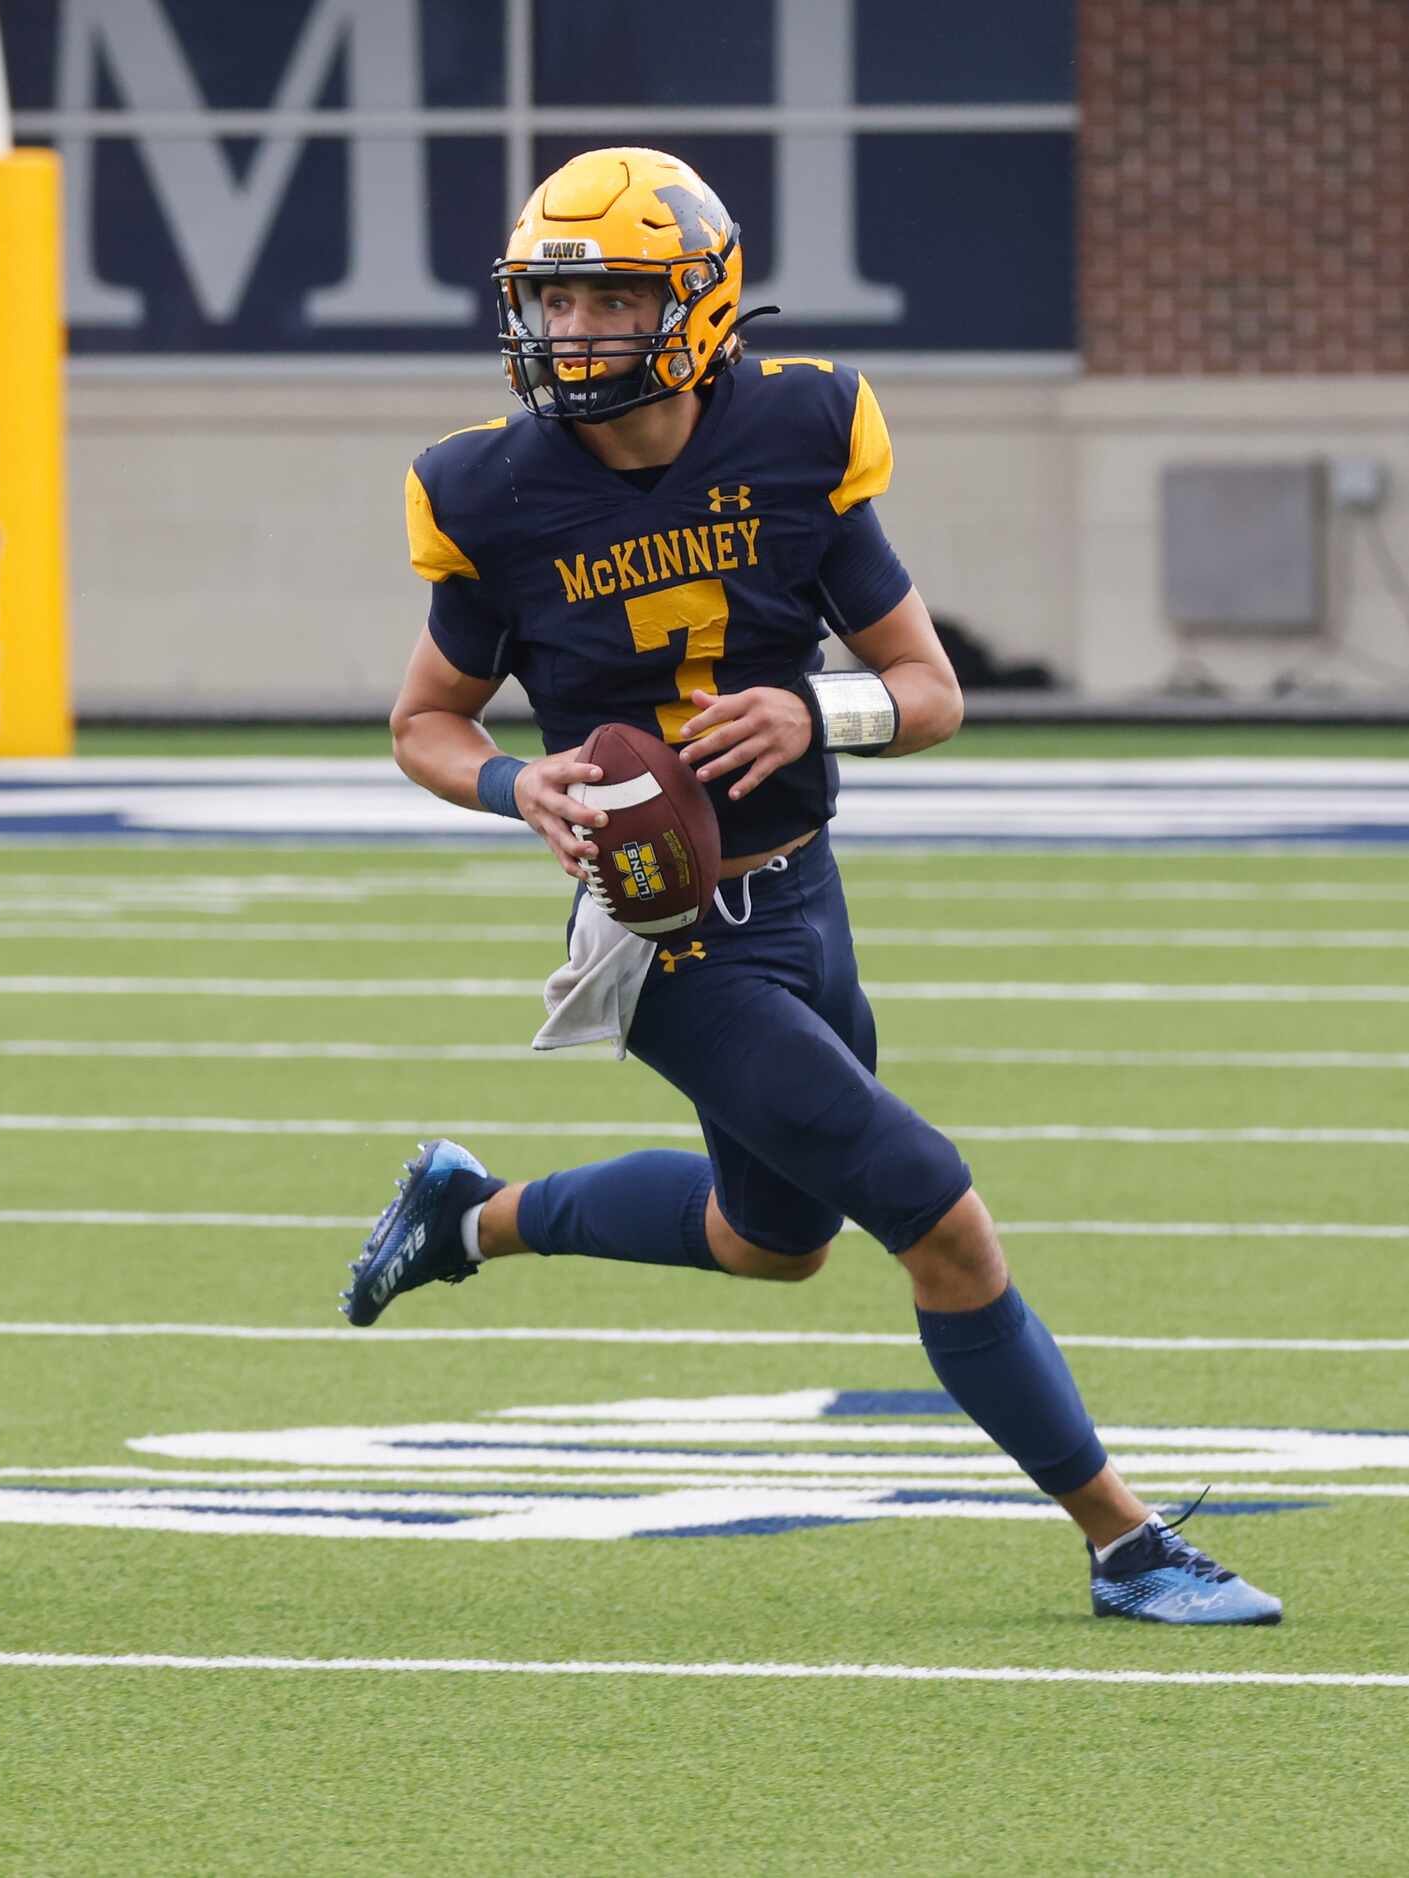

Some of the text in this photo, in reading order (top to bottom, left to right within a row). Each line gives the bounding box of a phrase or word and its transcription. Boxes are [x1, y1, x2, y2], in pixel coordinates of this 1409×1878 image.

[542, 242, 586, 258] WAWG
[554, 518, 760, 603] McKINNEY
[624, 578, 729, 744] 7
[626, 848, 651, 896] LIONS
